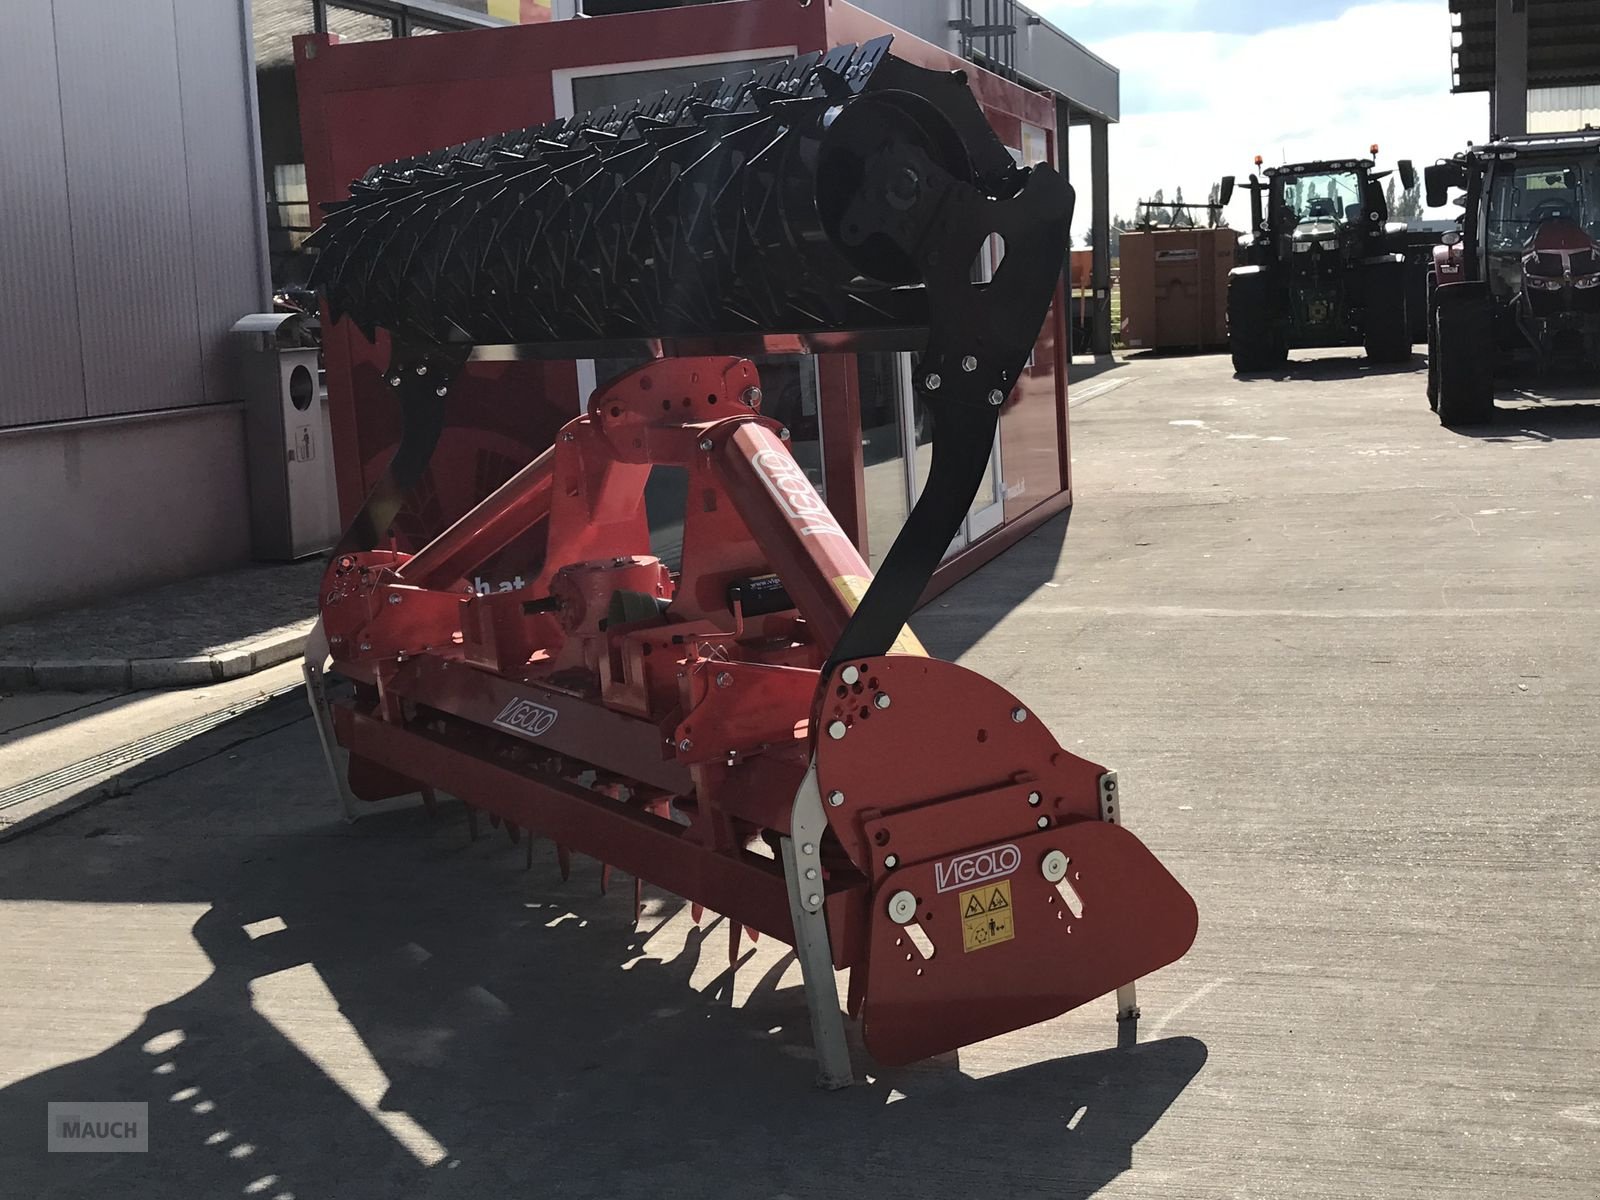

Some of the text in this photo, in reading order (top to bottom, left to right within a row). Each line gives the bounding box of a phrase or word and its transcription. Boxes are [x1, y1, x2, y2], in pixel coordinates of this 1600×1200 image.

[756, 450, 845, 536] VIGOLO
[496, 697, 557, 735] VIGOLO
[936, 846, 1019, 890] VIGOLO
